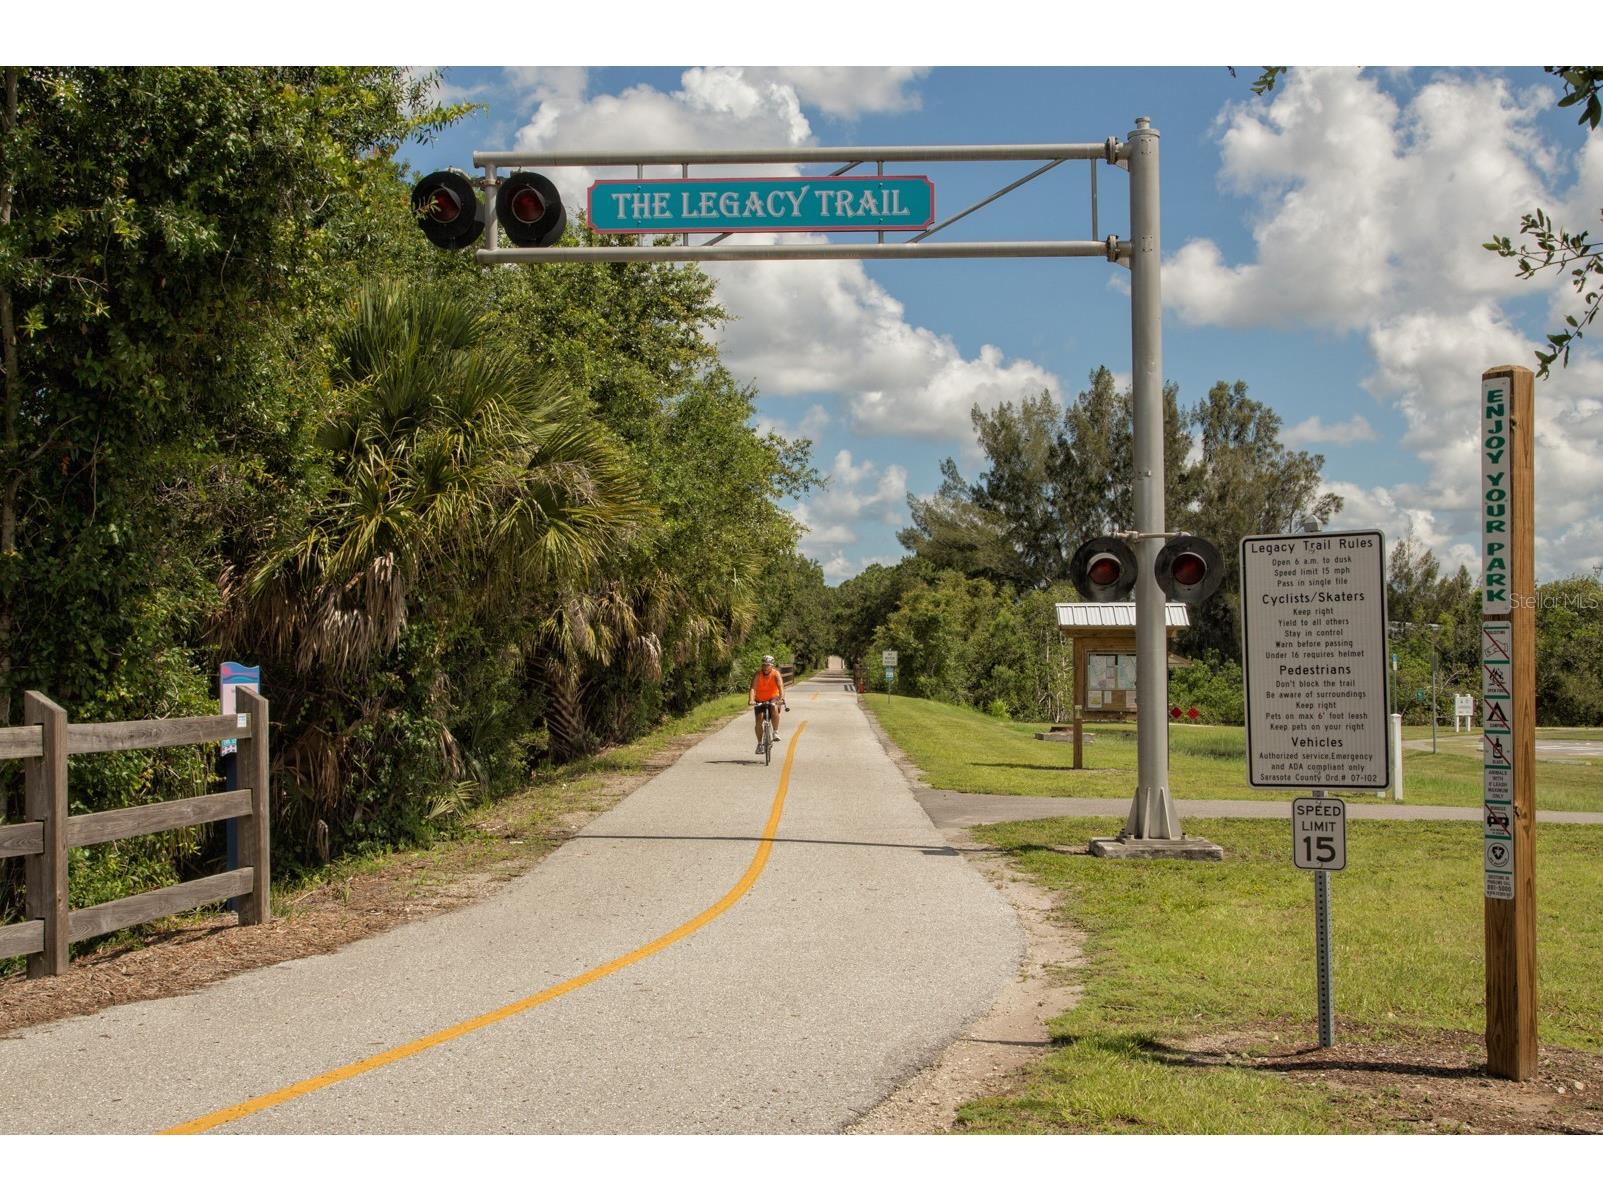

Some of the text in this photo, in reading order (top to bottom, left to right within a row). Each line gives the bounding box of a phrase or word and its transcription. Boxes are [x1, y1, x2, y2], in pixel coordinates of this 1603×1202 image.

[611, 185, 910, 219] THE LEGACY TRAIL
[1485, 390, 1506, 601] ENJOY YOUR PARK
[1251, 538, 1373, 555] Legacy Trail Rules
[1272, 559, 1290, 567] Open
[1274, 569, 1296, 577] Speed
[1334, 567, 1350, 575] mph
[1309, 579, 1331, 587] single
[1262, 592, 1365, 606] Cyclists/Skaters
[1315, 608, 1333, 616] right
[1284, 630, 1300, 638] Stay
[1304, 652, 1334, 660] requires
[1280, 665, 1351, 675] Pedestrians
[1346, 723, 1364, 732] right
[1292, 737, 1344, 747] Vehicles
[1260, 752, 1298, 760] Authorized
[1348, 764, 1365, 772] only
[1295, 774, 1321, 782] County
[1297, 806, 1341, 816] SPEED
[1302, 821, 1336, 832] LIMIT
[1303, 836, 1336, 862] 15
